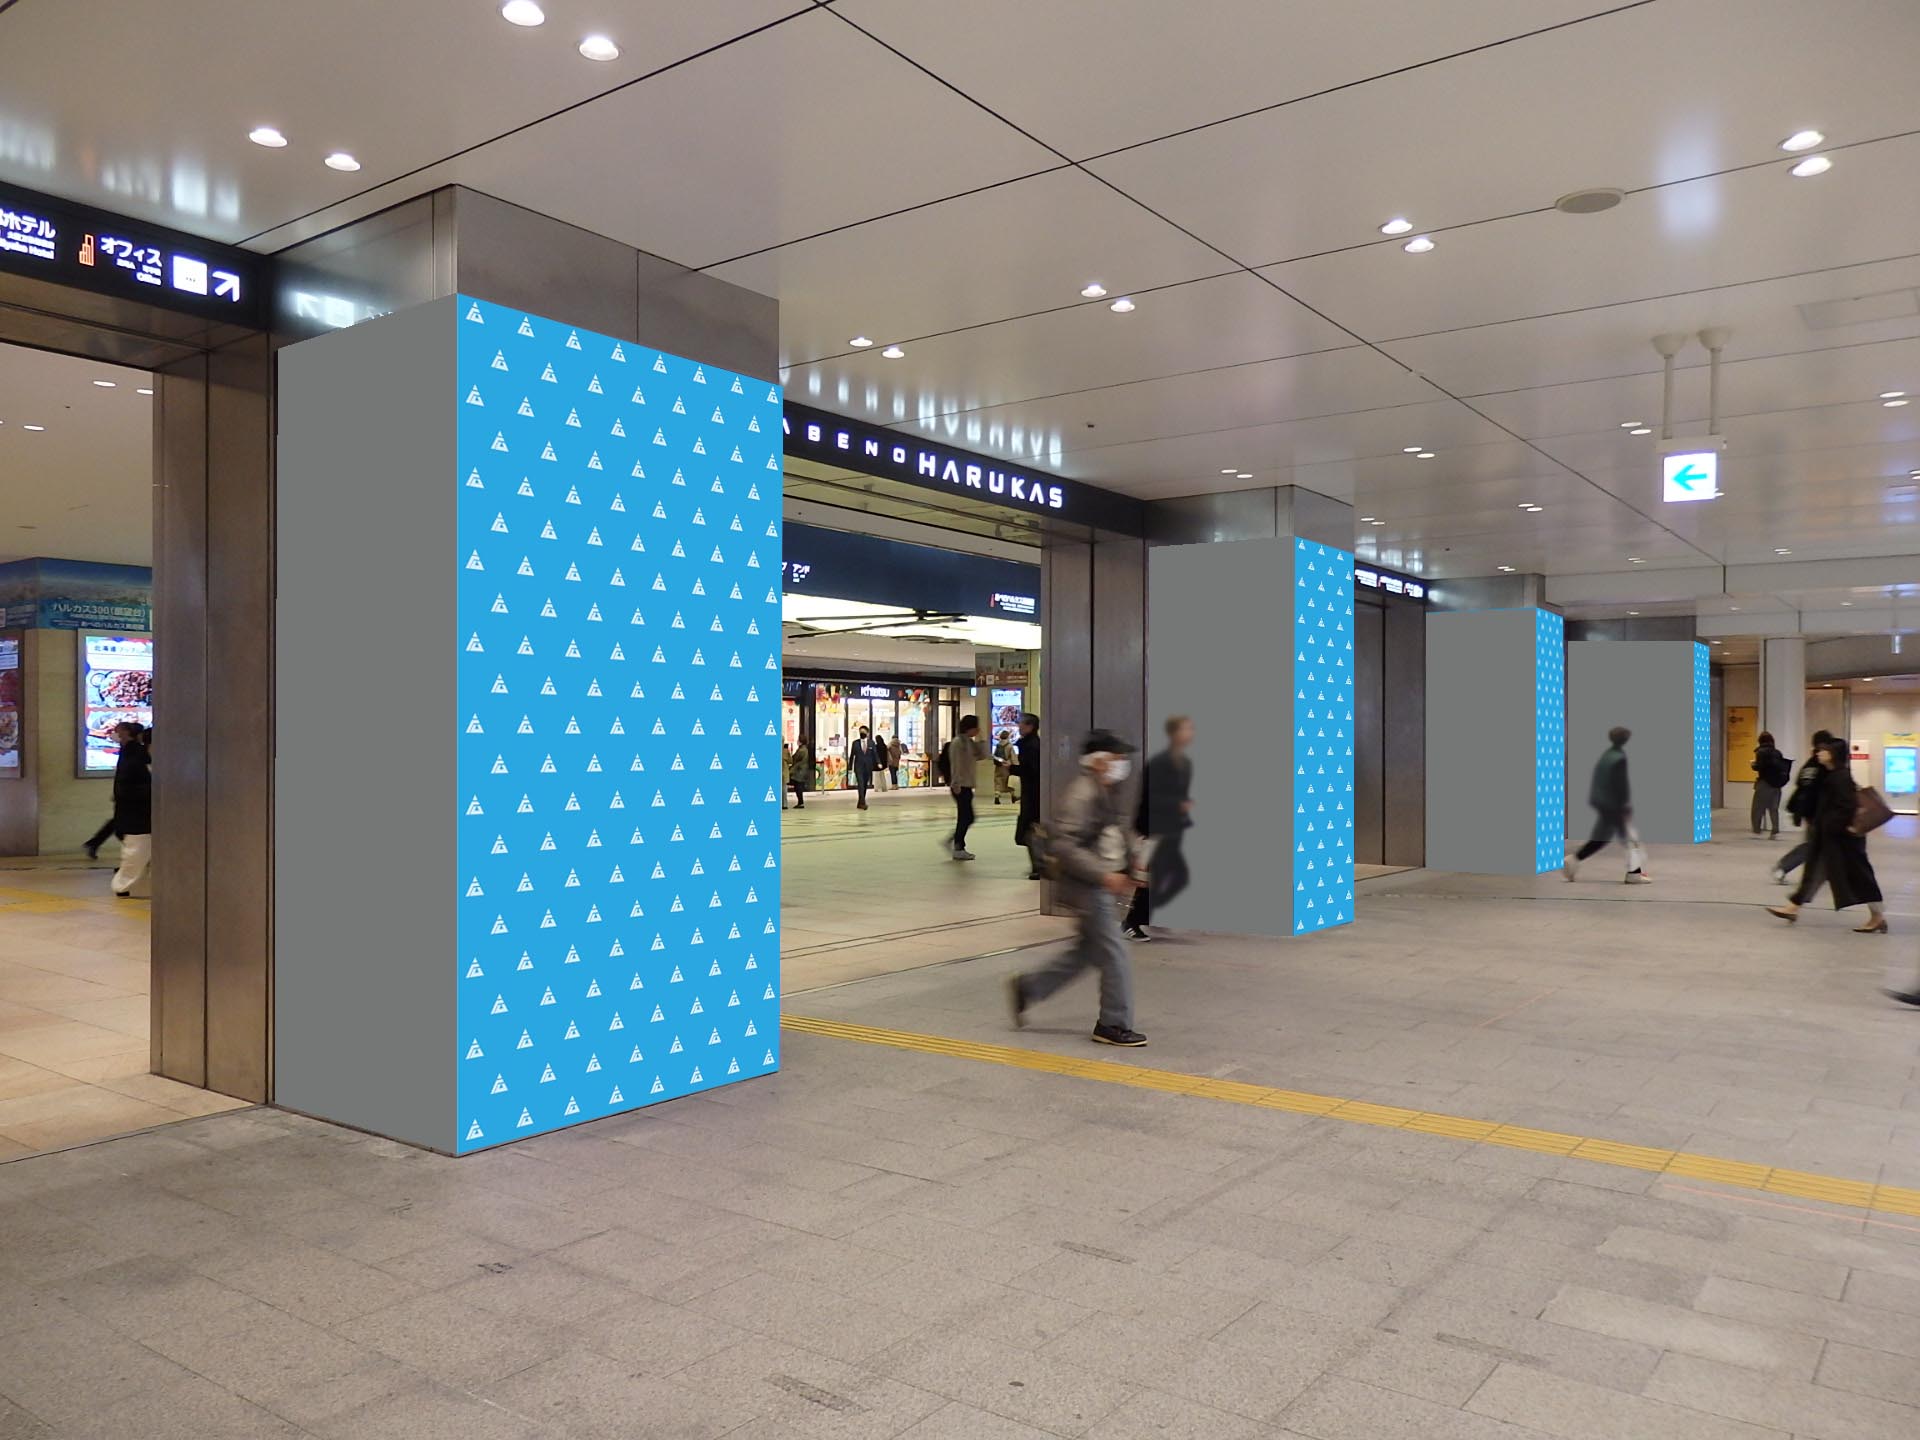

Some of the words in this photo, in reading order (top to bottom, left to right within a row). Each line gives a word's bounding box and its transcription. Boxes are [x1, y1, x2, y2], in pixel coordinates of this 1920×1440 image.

[100, 237, 163, 267] オフィス
[918, 452, 1064, 509] HARUKAS
